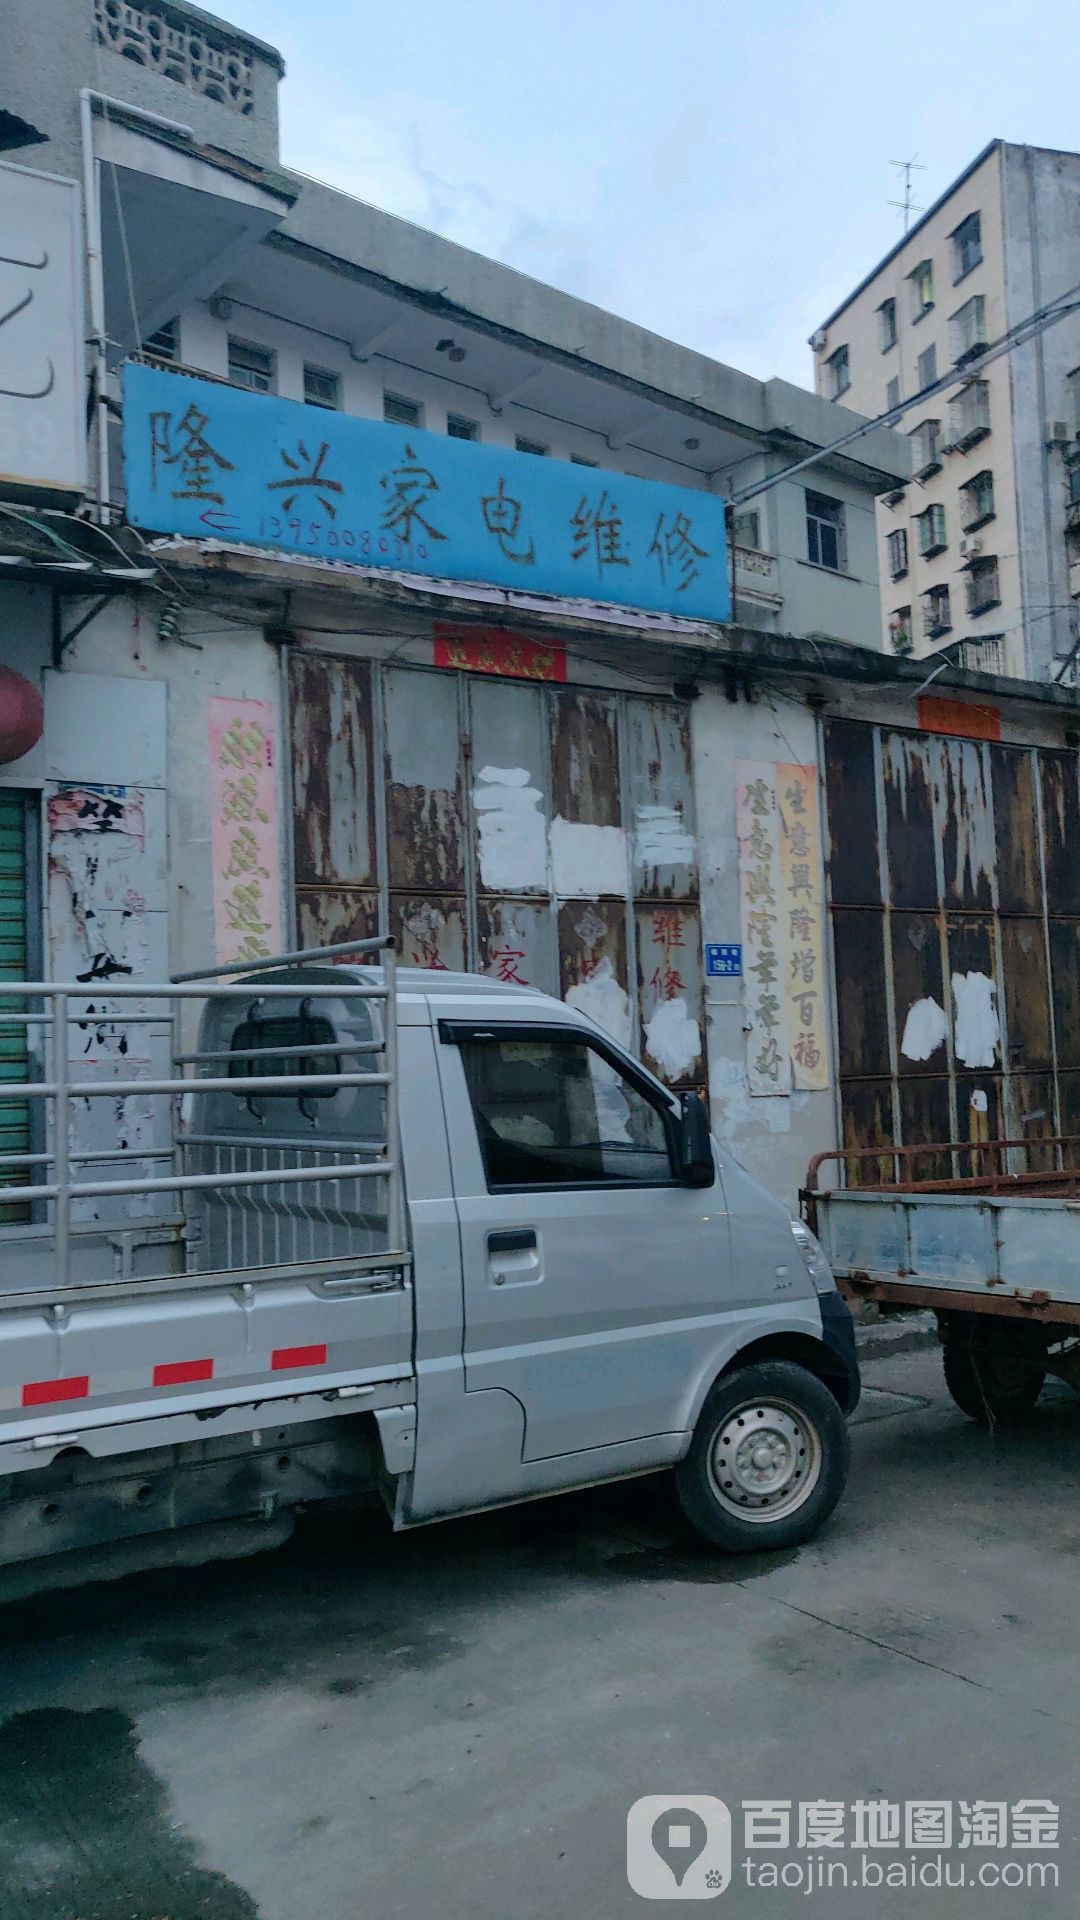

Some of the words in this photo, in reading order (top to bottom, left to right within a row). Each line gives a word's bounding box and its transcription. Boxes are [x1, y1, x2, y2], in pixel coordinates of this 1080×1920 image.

[149, 402, 709, 592] 隆兴家电维修
[784, 779, 820, 1070] 生意興隆增百福
